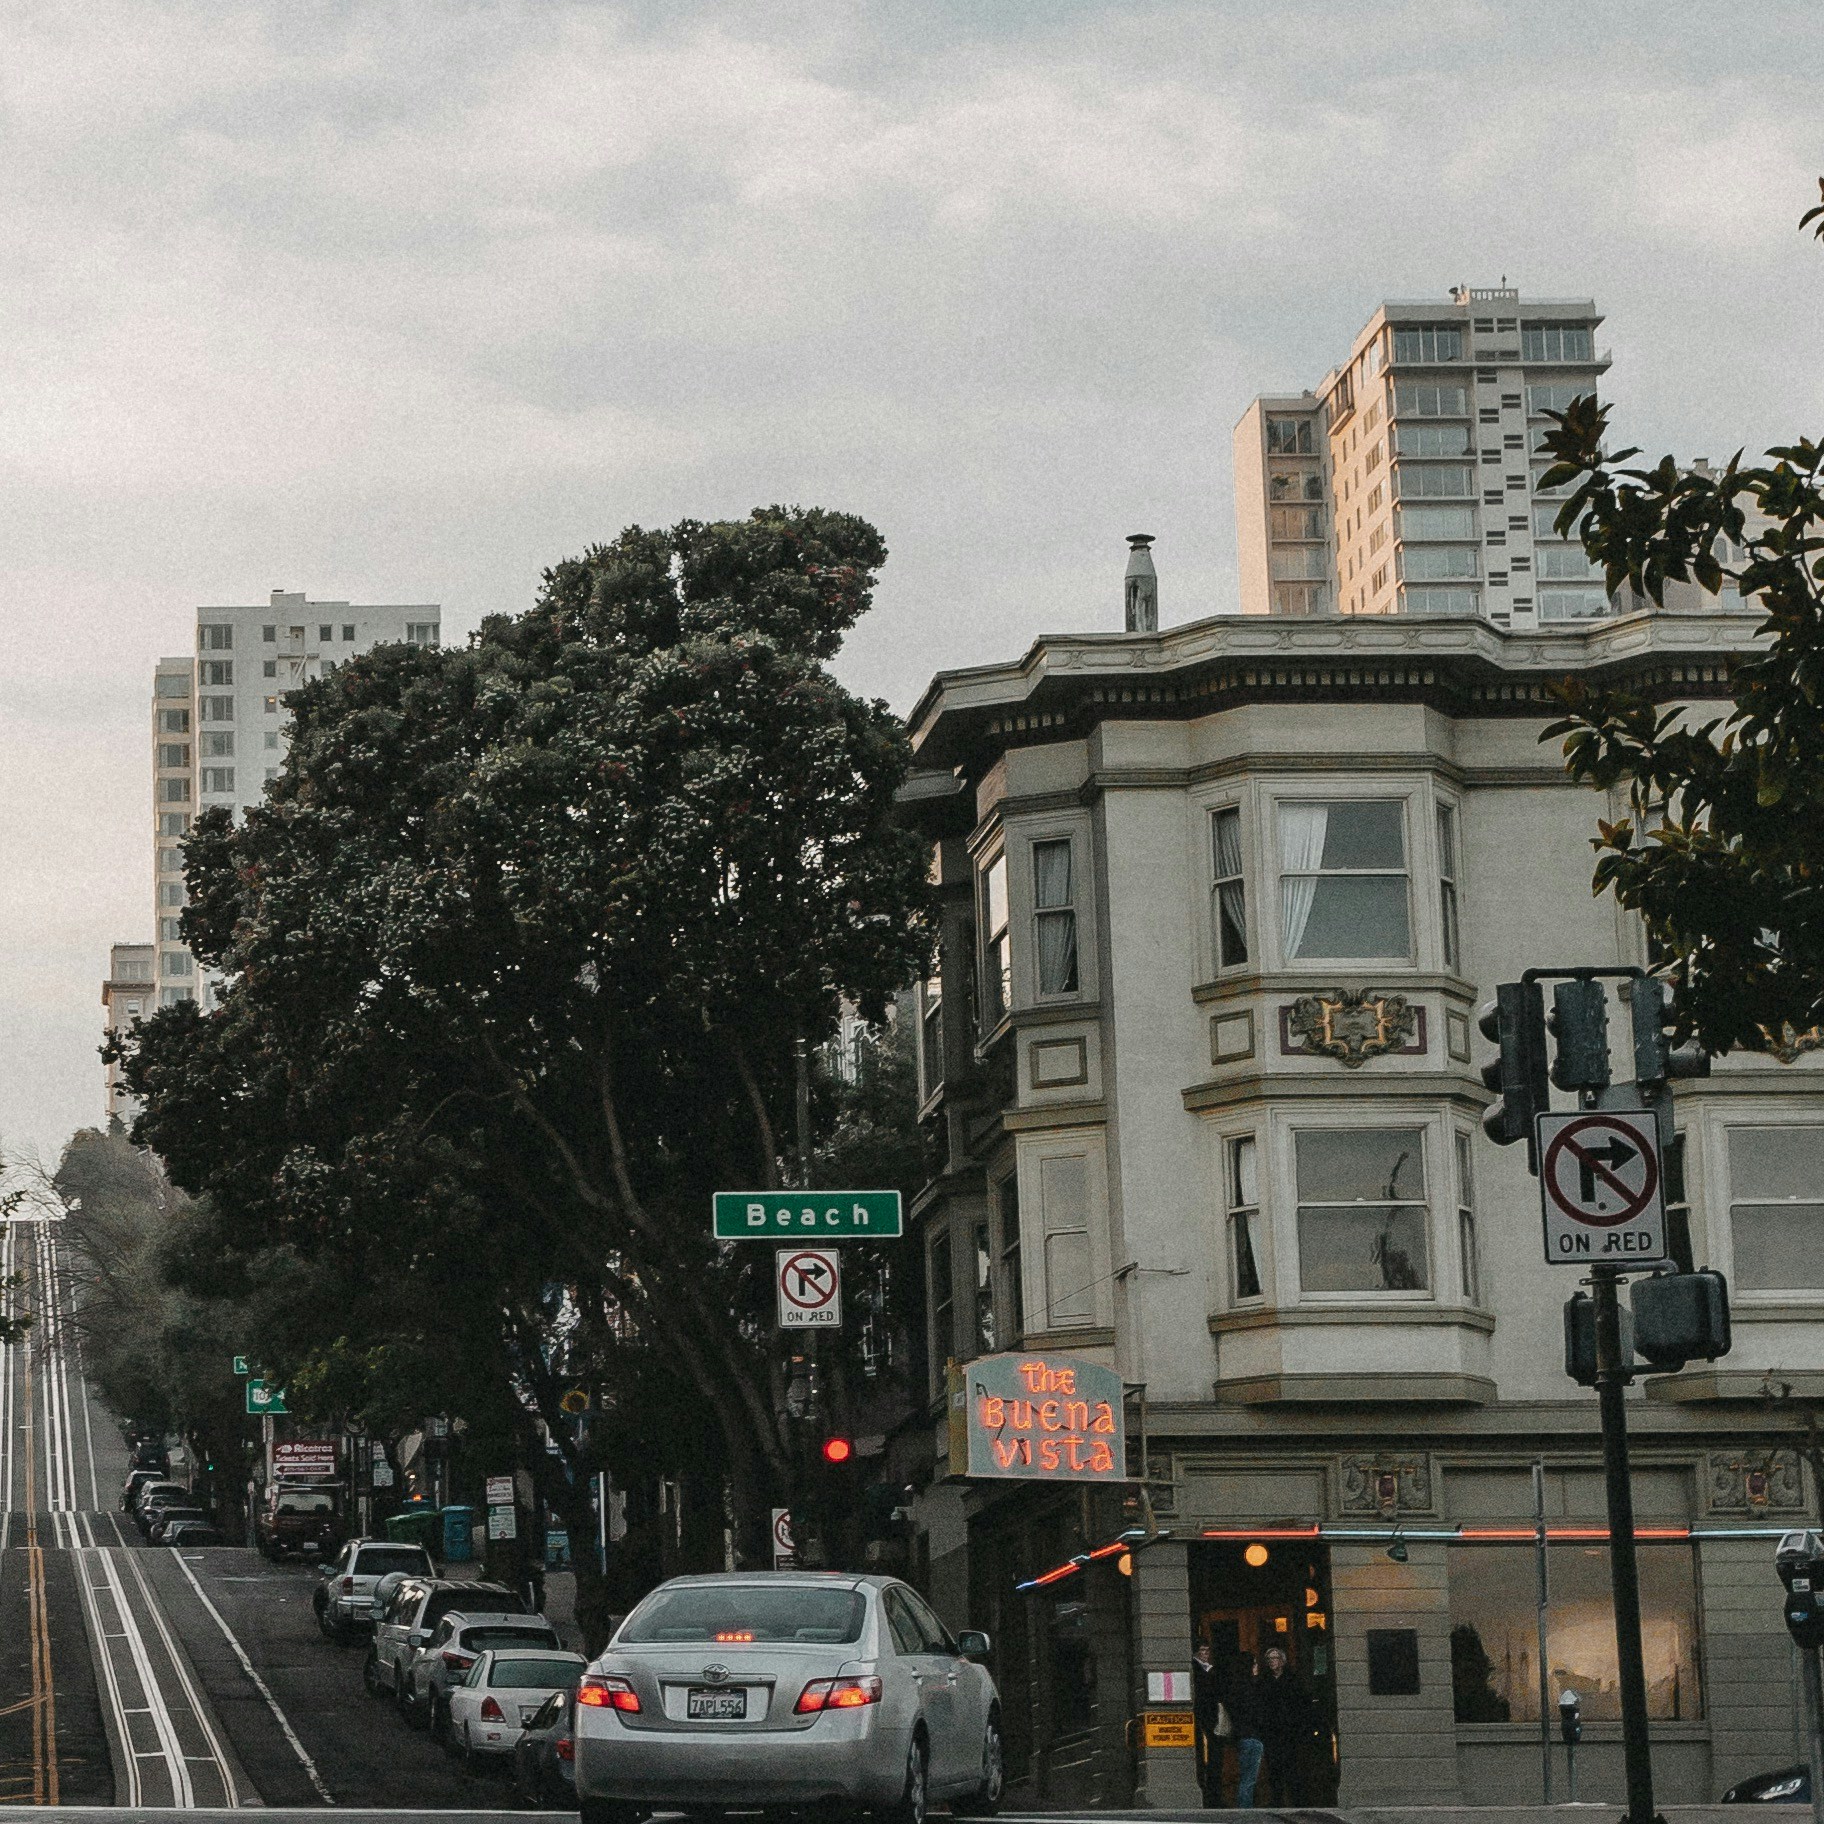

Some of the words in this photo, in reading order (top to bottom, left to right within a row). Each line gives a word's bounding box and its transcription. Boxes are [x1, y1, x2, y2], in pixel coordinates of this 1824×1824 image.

[746, 1202, 869, 1226] Beach
[1559, 1233, 1590, 1253] ON
[1606, 1231, 1653, 1252] RED
[787, 1311, 803, 1322] ON
[808, 1310, 834, 1322] RED
[293, 1443, 333, 1453] Alcatraz
